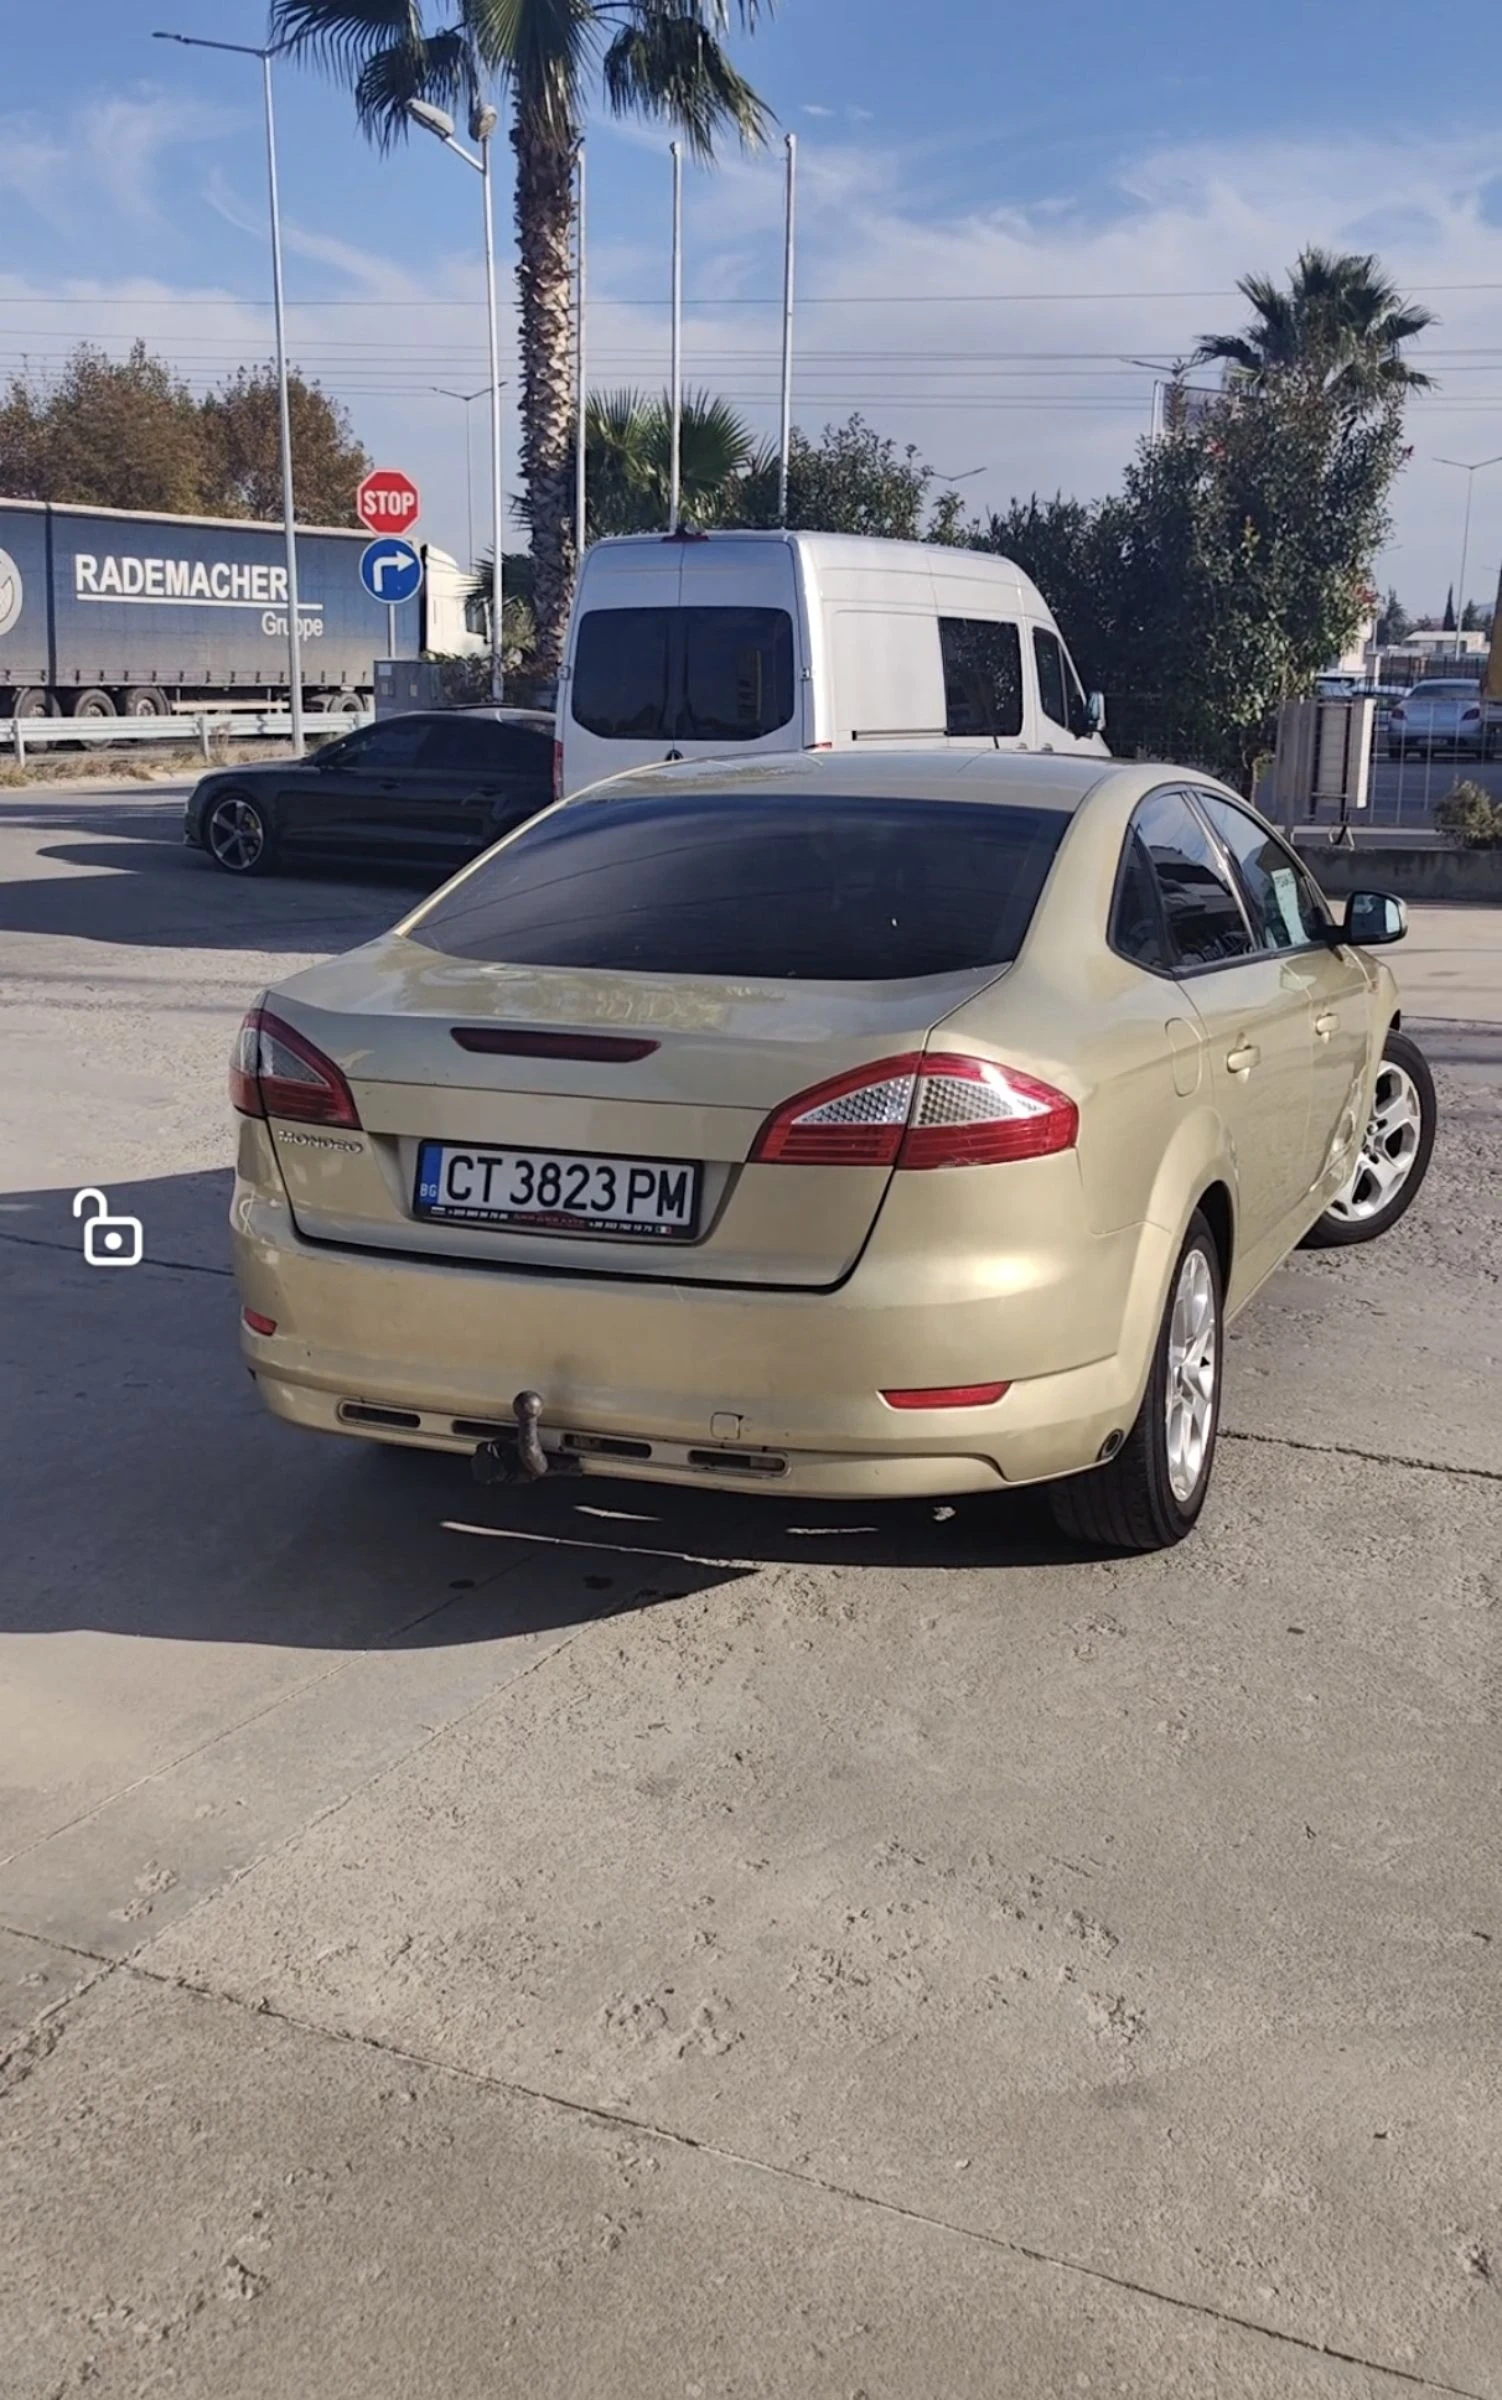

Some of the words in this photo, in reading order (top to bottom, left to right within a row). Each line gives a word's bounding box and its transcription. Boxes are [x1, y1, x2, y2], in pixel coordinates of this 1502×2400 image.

[363, 490, 415, 516] STOP
[75, 554, 288, 601] RADEMACHER
[420, 1183, 437, 1198] BG
[446, 1155, 502, 1202] CT
[509, 1159, 616, 1212] 3823
[626, 1167, 687, 1218] PM
